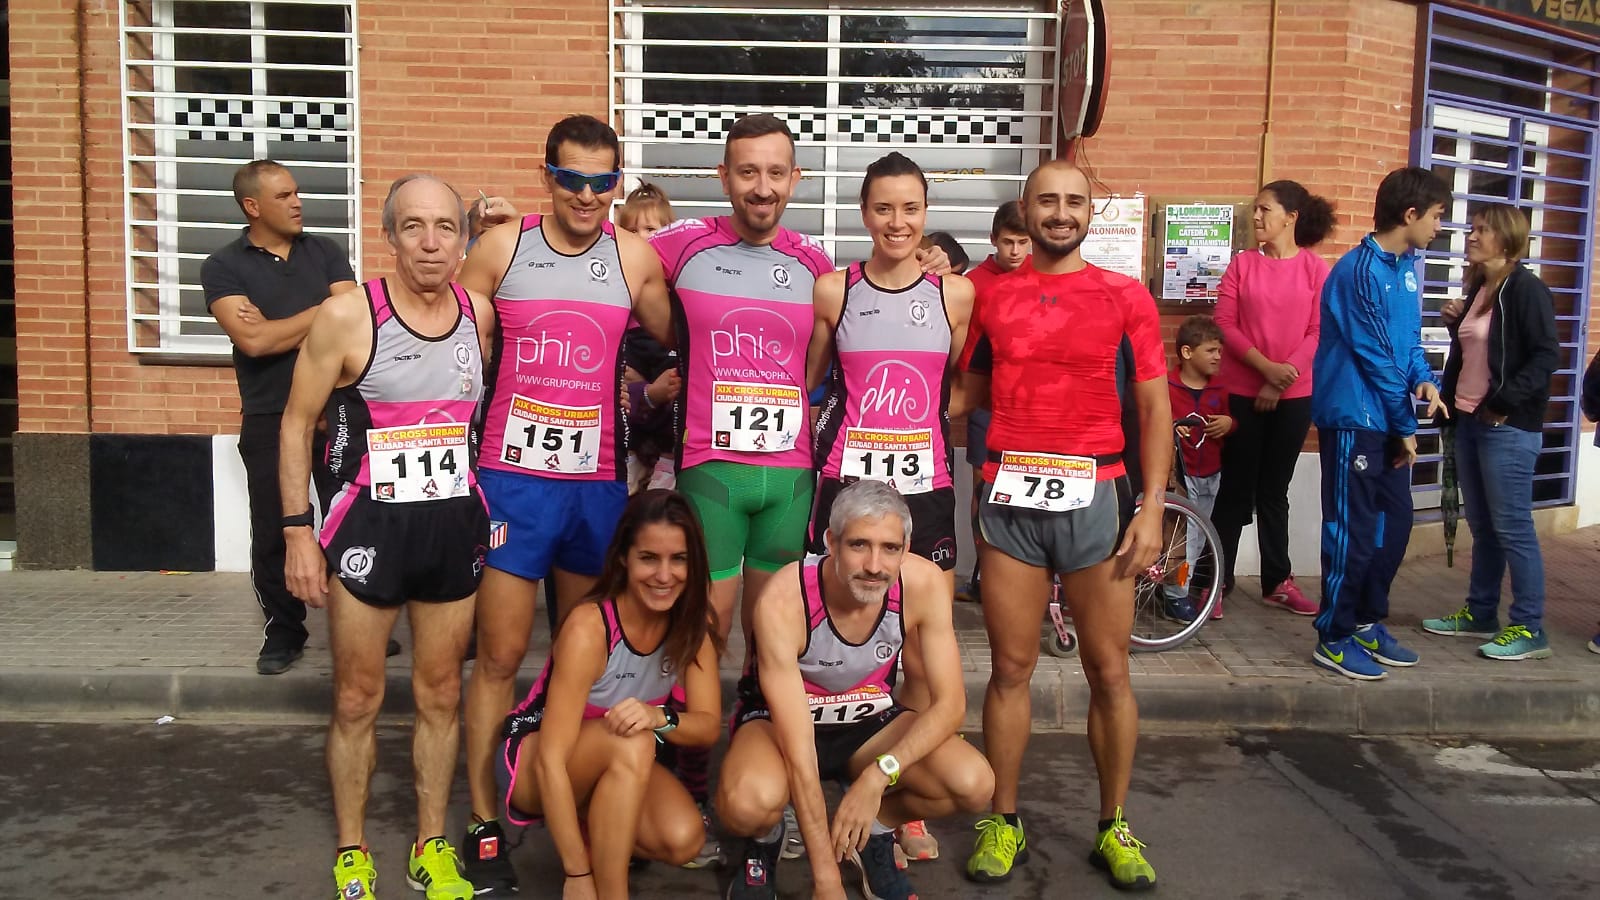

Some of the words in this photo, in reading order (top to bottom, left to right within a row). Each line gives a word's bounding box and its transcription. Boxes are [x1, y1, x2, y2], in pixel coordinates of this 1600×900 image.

[1062, 41, 1087, 88] STOP
[1088, 227, 1137, 235] ALONMANO
[722, 268, 742, 276] TACTIC
[515, 330, 572, 373] phi
[711, 324, 764, 367] phi
[716, 386, 732, 394] XIX
[734, 386, 764, 395] CROSS
[765, 389, 799, 398] URBANO
[857, 367, 911, 429] phi
[513, 408, 538, 421] CIUDAD
[539, 415, 549, 423] DE
[550, 417, 575, 427] SANTA
[576, 419, 599, 427] TERESA
[514, 398, 529, 410] XIX
[530, 405, 561, 417] CROSS
[563, 410, 599, 419] URBANO
[729, 406, 785, 432] 121
[394, 429, 428, 440] CROSS
[430, 427, 465, 437] URBANO
[523, 424, 583, 454] 151
[849, 432, 863, 440] XIX
[864, 433, 894, 442] CROSS
[896, 433, 929, 442] URBANO
[372, 441, 403, 450] CIUDAD
[404, 440, 418, 449] DE
[417, 438, 442, 447] SANTA
[442, 437, 465, 445] TERESA
[908, 441, 930, 449] TERESA
[391, 448, 457, 479] 114
[860, 452, 920, 477] 113
[1003, 464, 1027, 472] CIUDAD
[1039, 467, 1063, 475] SANTA
[1064, 469, 1092, 478] TERESA
[1019, 457, 1050, 466] CROSS
[1051, 459, 1092, 470] URBANO
[1023, 475, 1065, 500] 78
[808, 697, 824, 705] DAD
[837, 694, 860, 702] SANTA
[810, 702, 876, 721] 112
